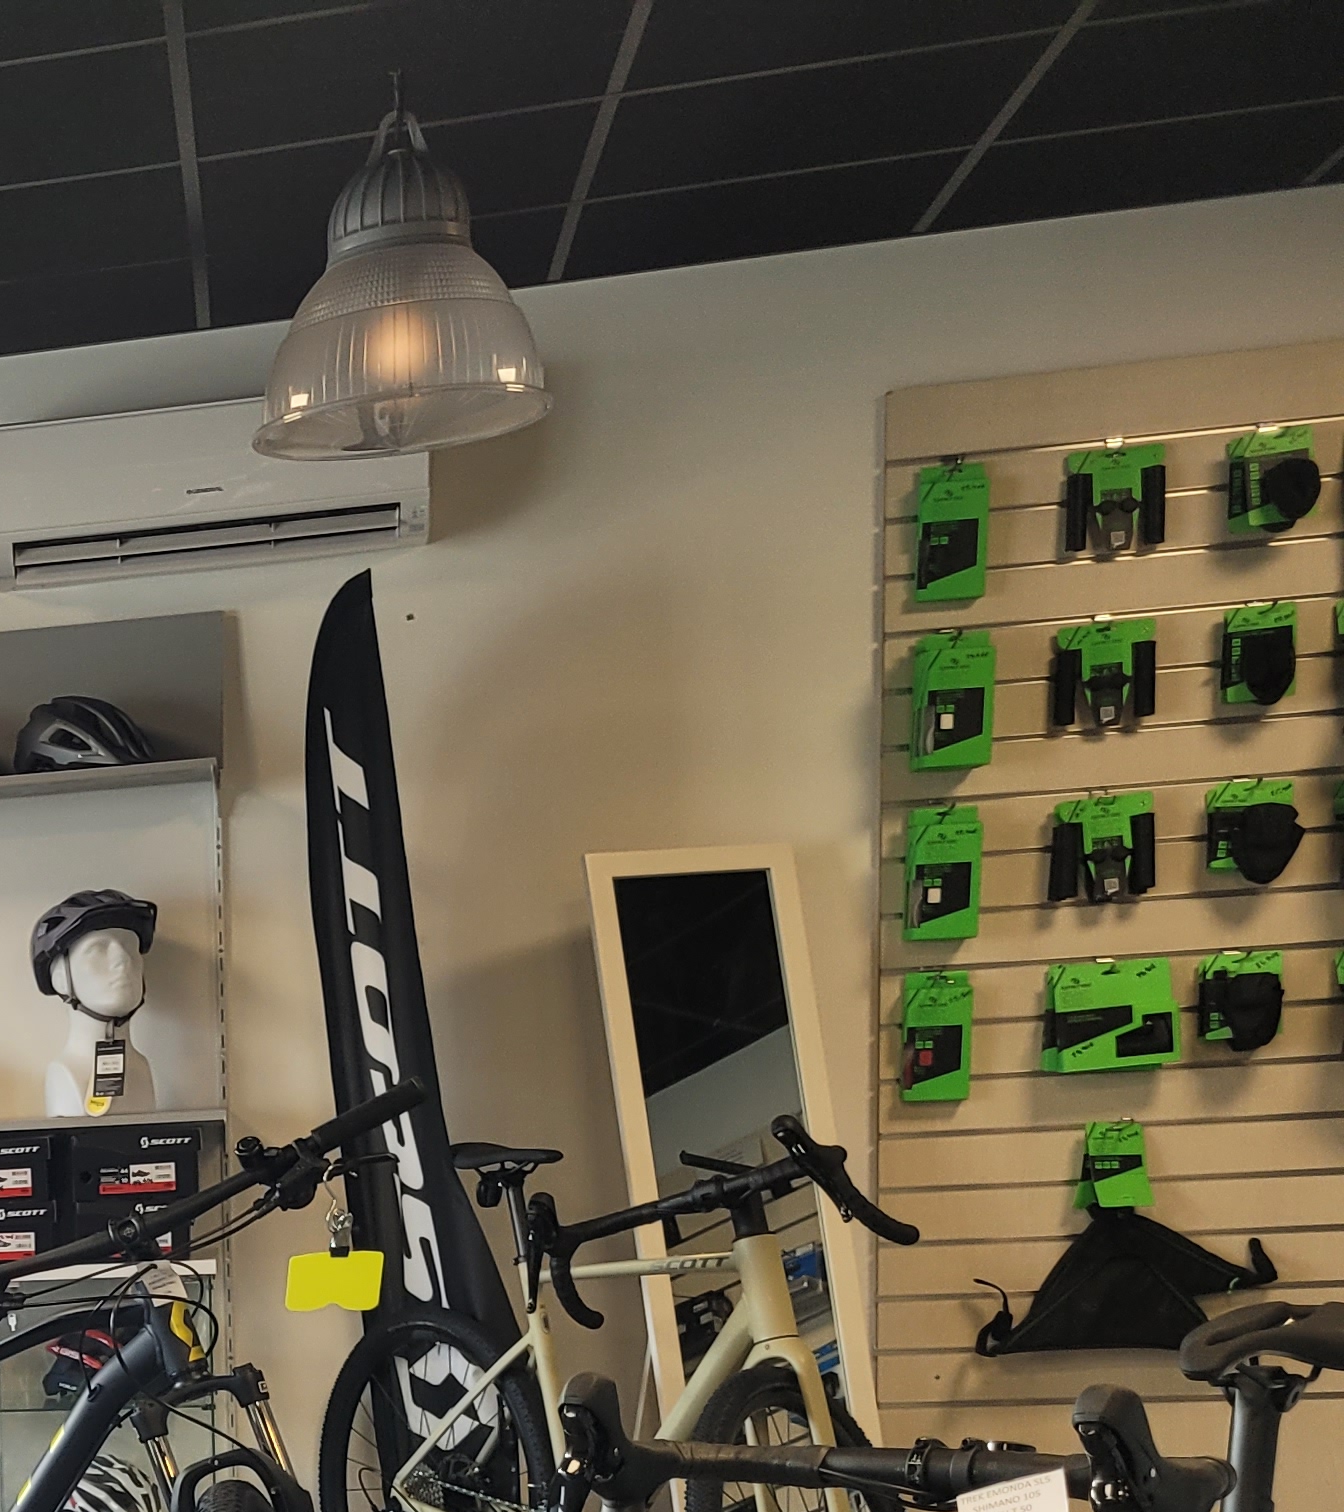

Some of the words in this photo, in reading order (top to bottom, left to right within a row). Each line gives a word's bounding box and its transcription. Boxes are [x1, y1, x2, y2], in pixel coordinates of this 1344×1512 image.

[323, 706, 450, 1310] SCOTT
[149, 1137, 192, 1146] SCOTT
[0, 1146, 41, 1156] SCOTT
[6, 1209, 48, 1218] SCOTT
[960, 1492, 985, 1505] TREK
[986, 1480, 1032, 1499] EMONDA
[1024, 1490, 1042, 1501] 105
[1020, 1504, 1033, 1512] 50
